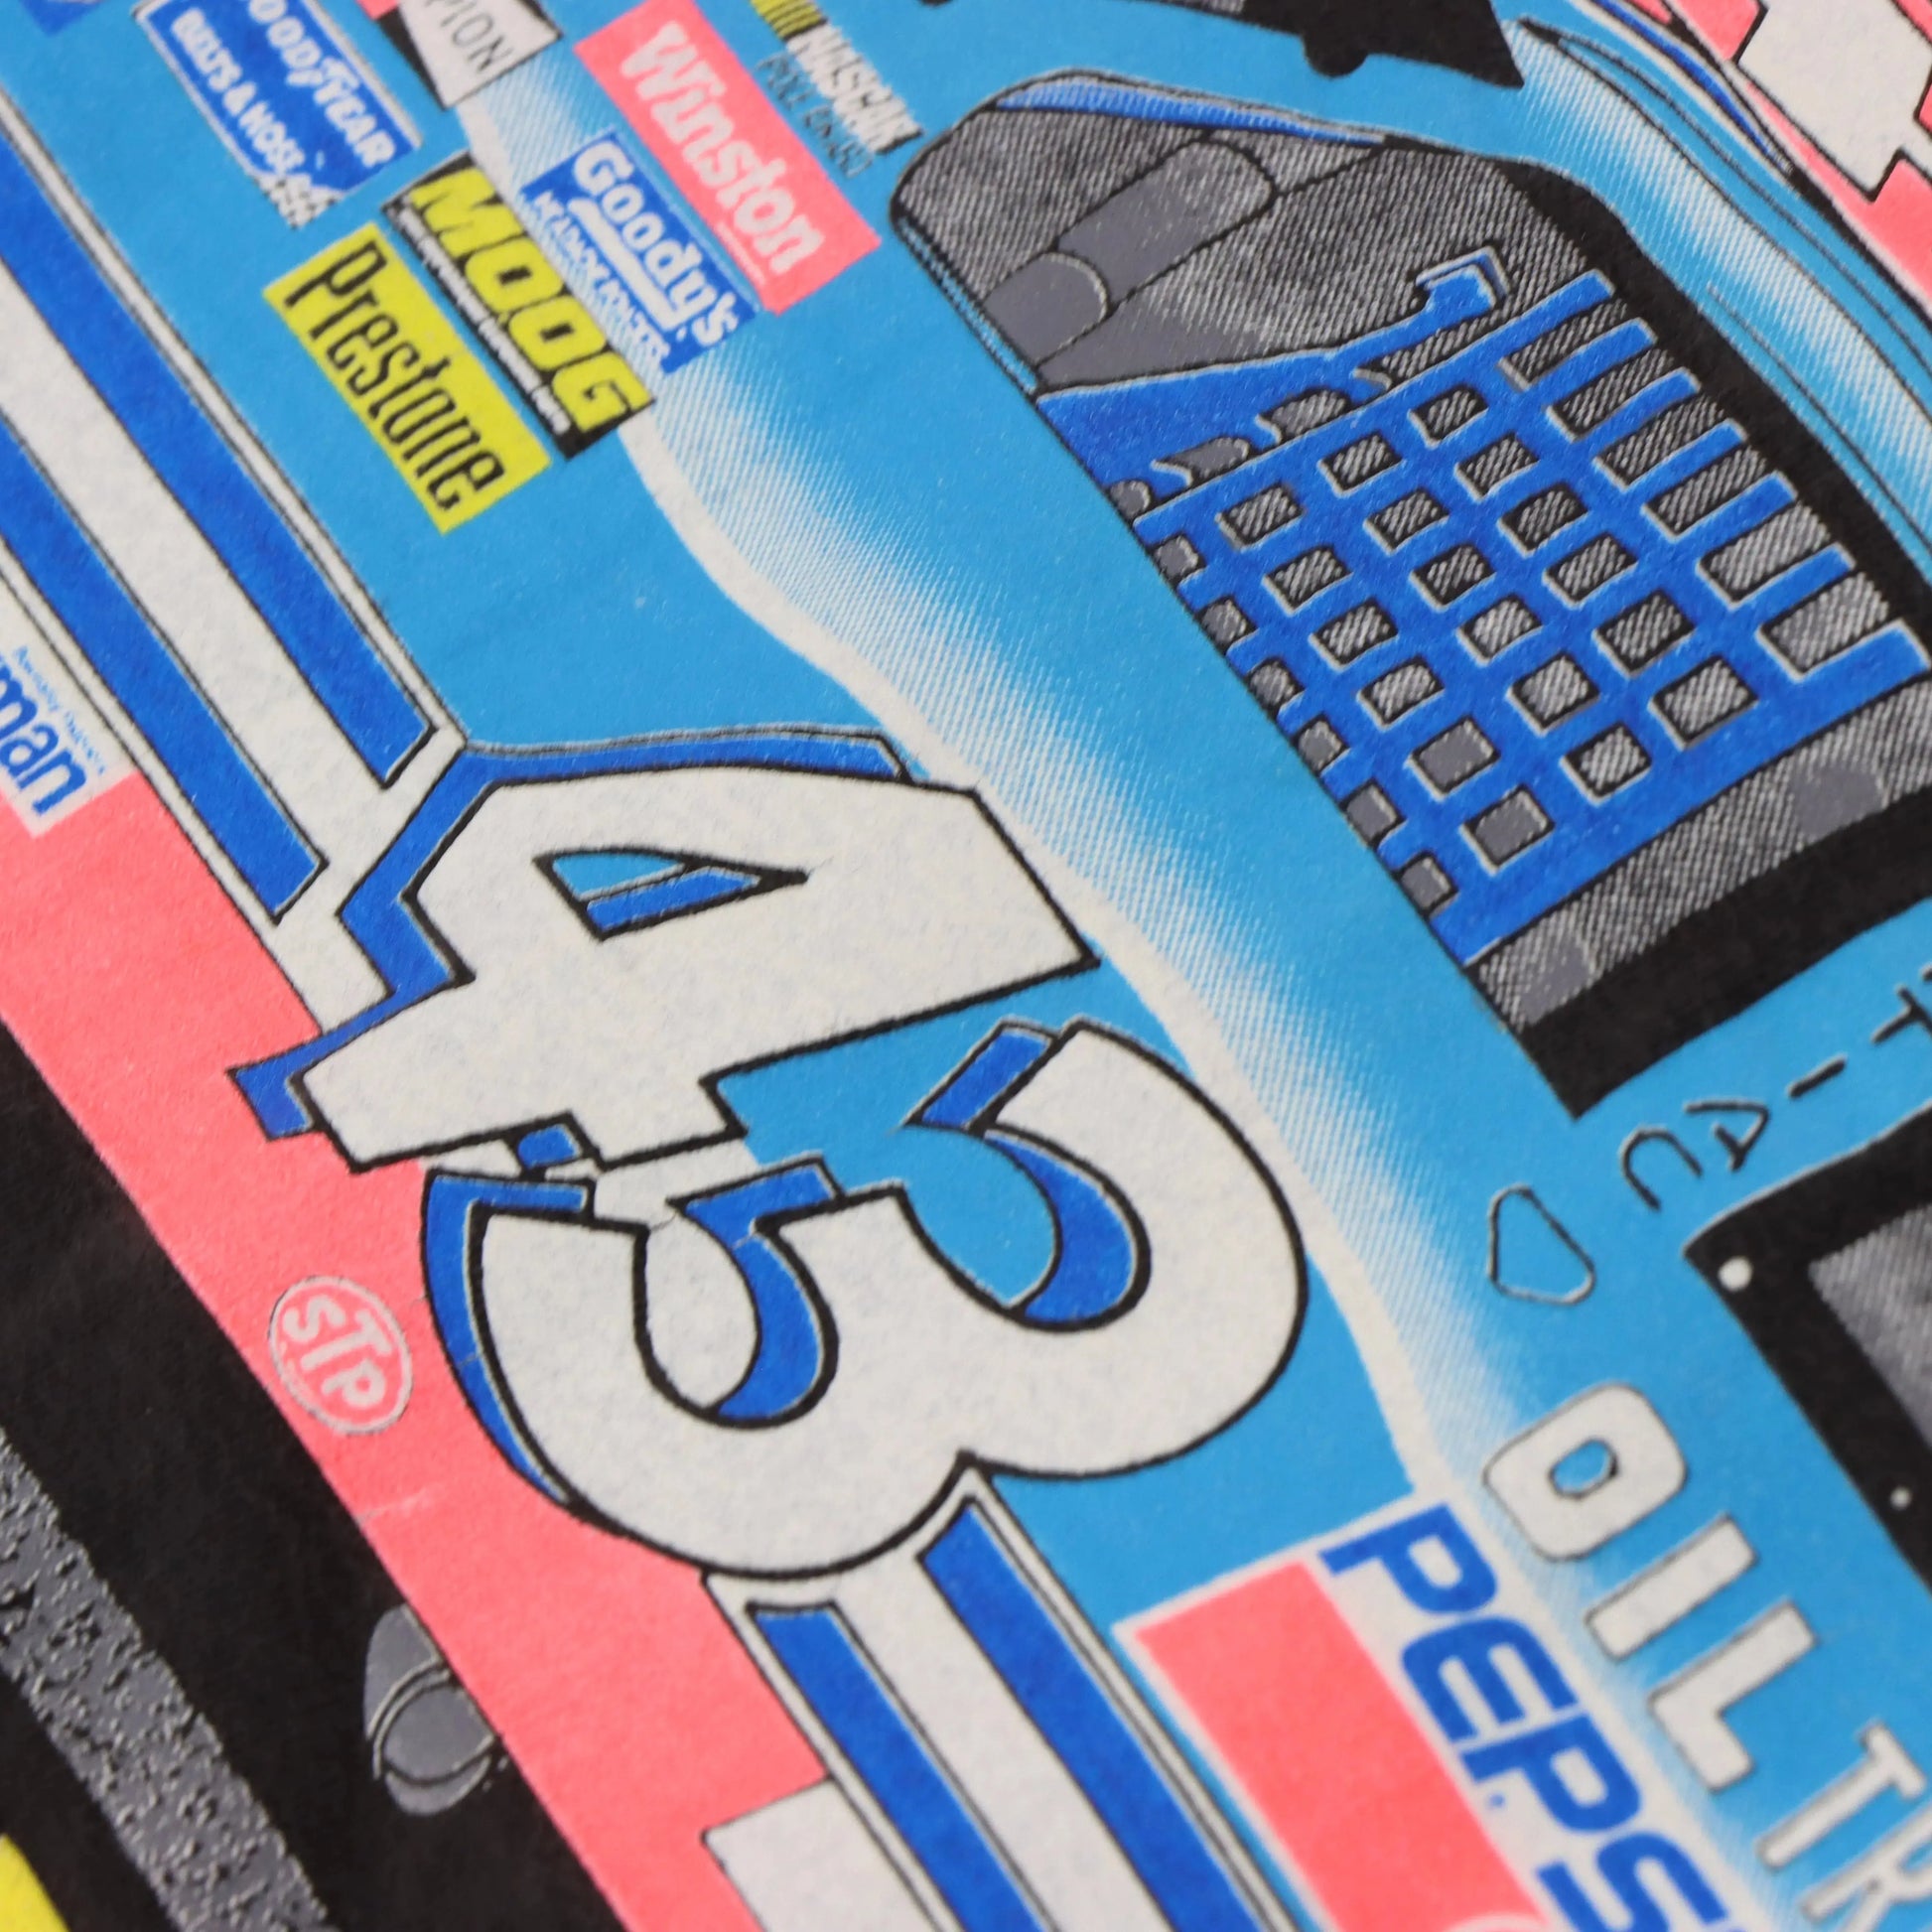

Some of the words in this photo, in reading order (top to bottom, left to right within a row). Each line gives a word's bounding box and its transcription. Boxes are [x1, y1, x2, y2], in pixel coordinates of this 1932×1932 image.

[425, 0, 514, 71] ION
[621, 20, 826, 275] Winston
[401, 166, 655, 434] MOOG
[568, 139, 739, 347] Goody's
[283, 239, 505, 512] Prestone
[0, 653, 87, 818] man
[238, 735, 1309, 1581] 43
[1618, 965, 1932, 1211] TIAC
[281, 1295, 393, 1410] STP
[1316, 1501, 1747, 1932] PEPS
[1482, 1382, 1822, 1795] OIL
[1754, 1722, 1932, 1932] TR
